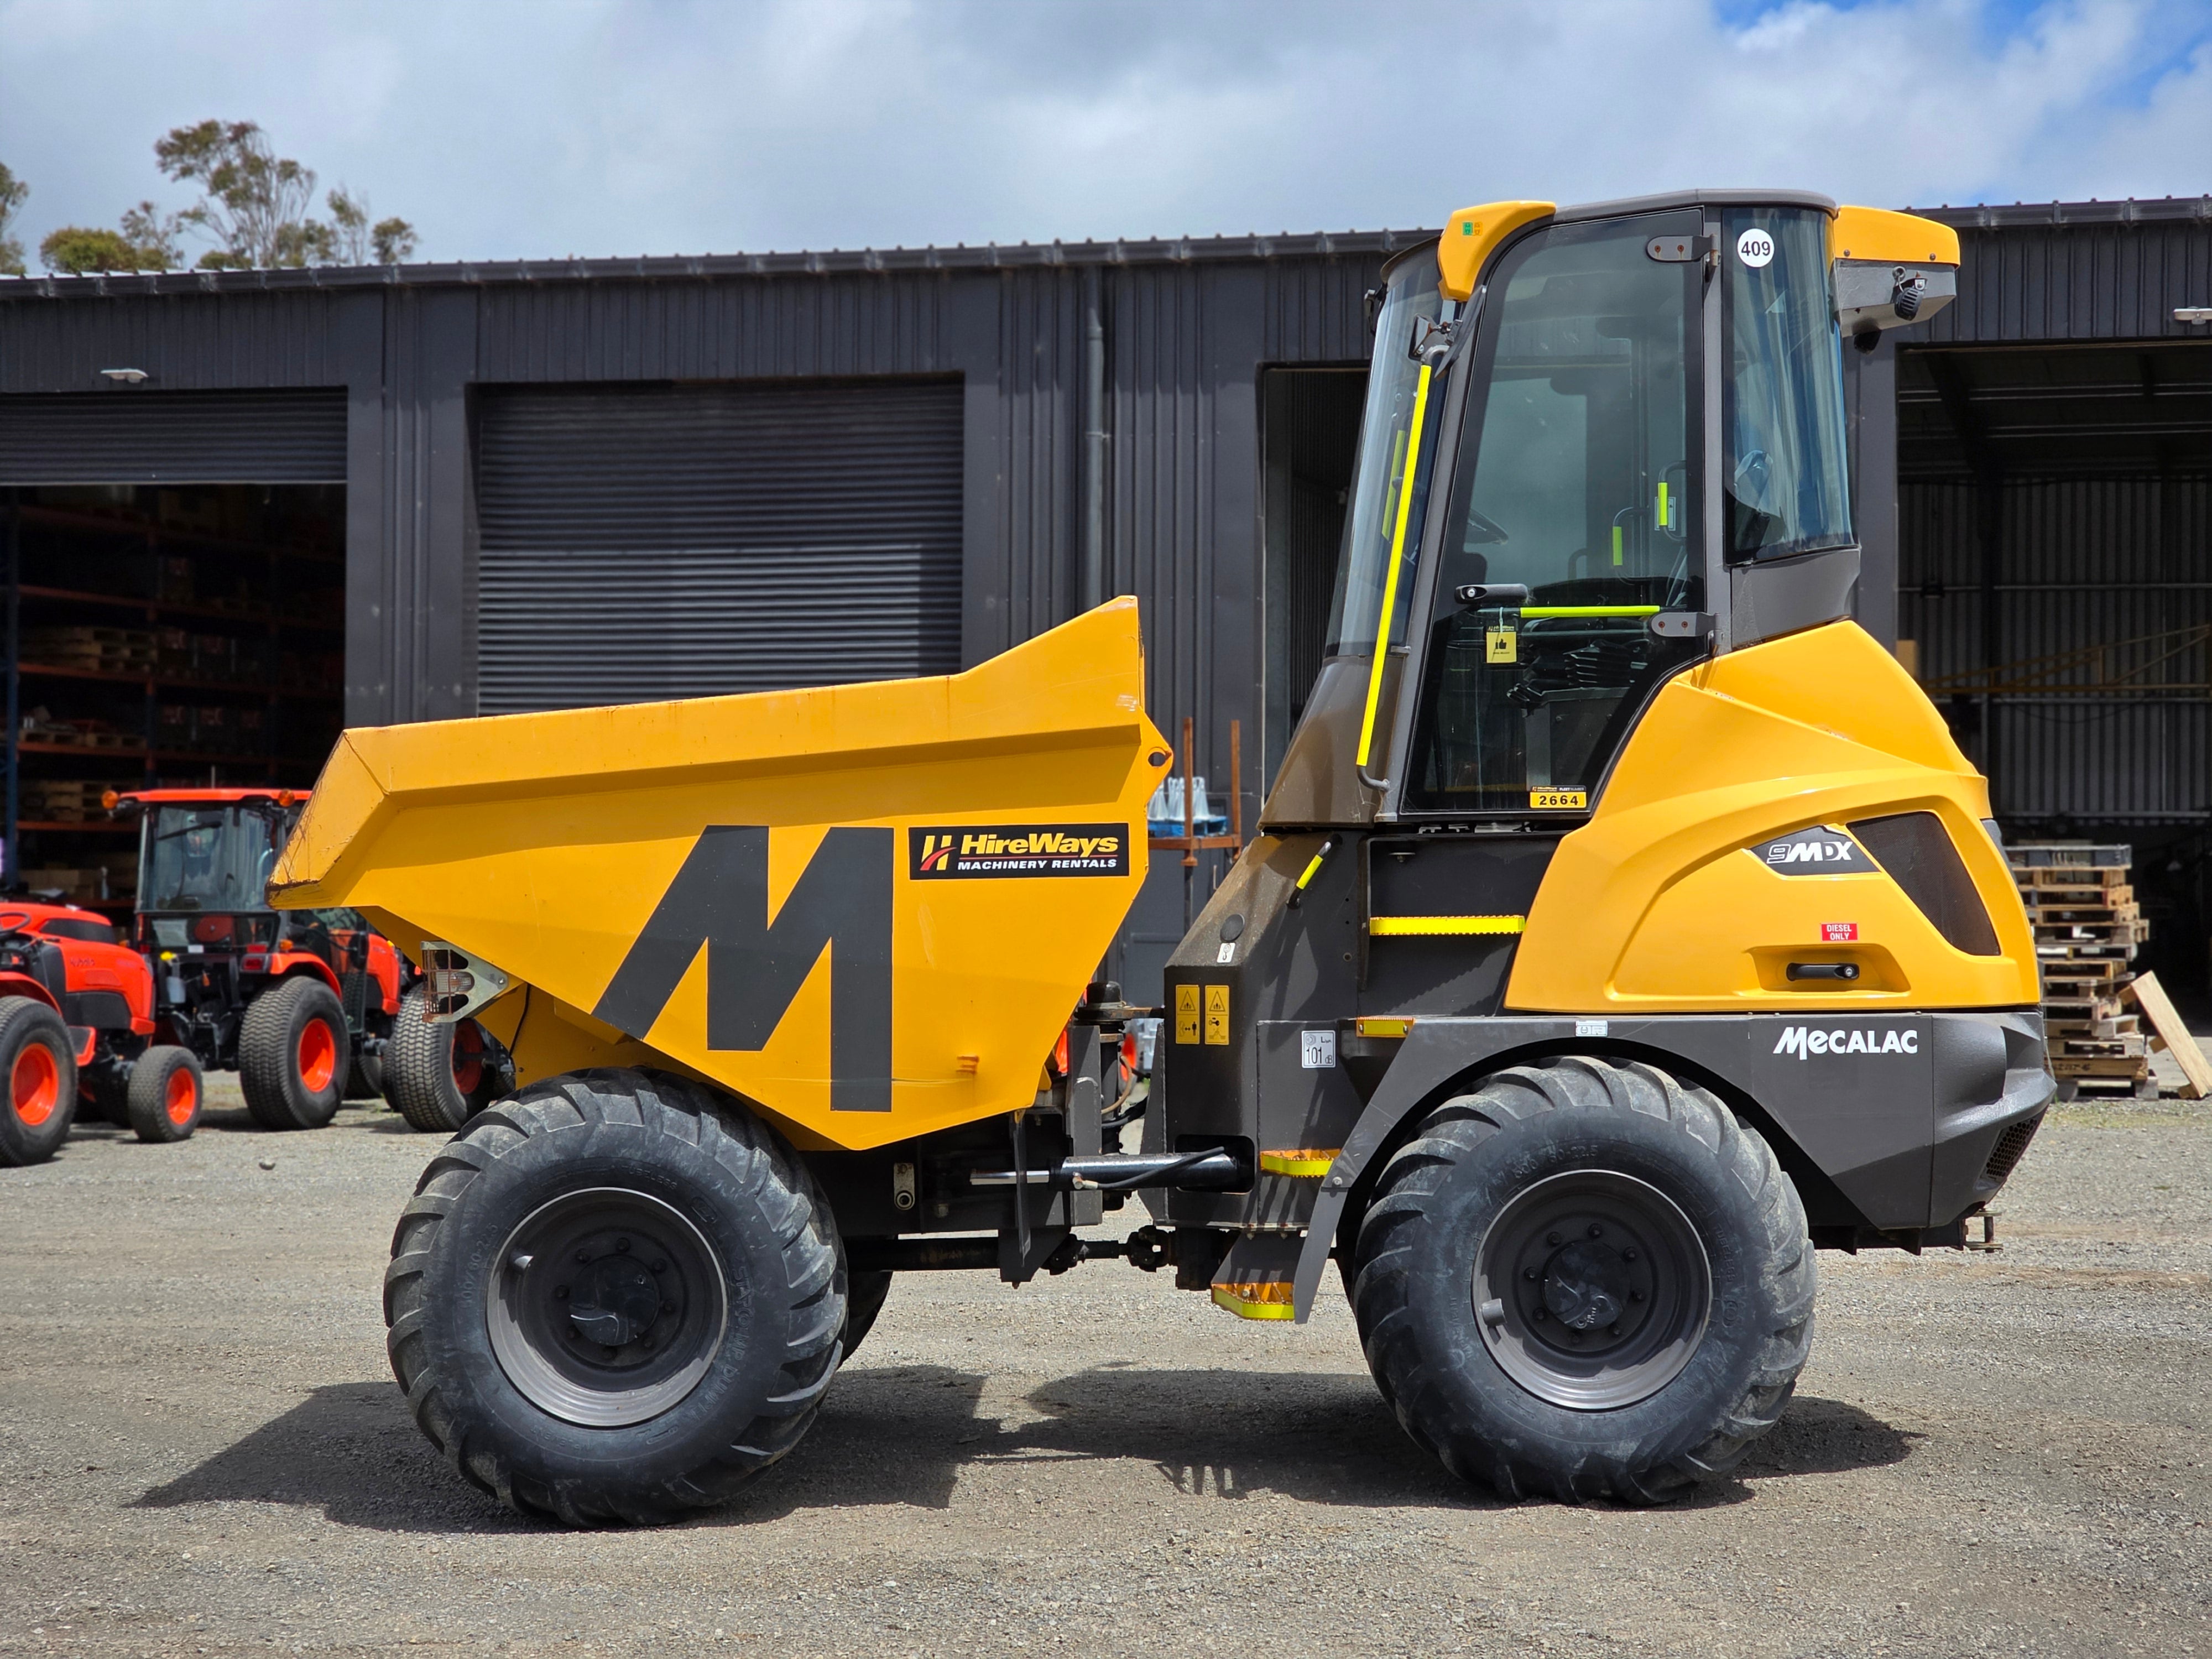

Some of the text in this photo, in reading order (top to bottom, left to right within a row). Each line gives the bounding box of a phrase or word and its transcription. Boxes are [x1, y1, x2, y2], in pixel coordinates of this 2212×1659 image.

[1741, 241, 1771, 257] 409
[1539, 795, 1578, 806] 2664
[961, 833, 1119, 858] HireWays
[1766, 841, 1853, 864] 9MDX
[957, 859, 1117, 870] MACHINERY RENTALS
[1830, 932, 1849, 941] ONLY
[591, 825, 894, 1113] M
[1306, 1046, 1333, 1064] 101 dB
